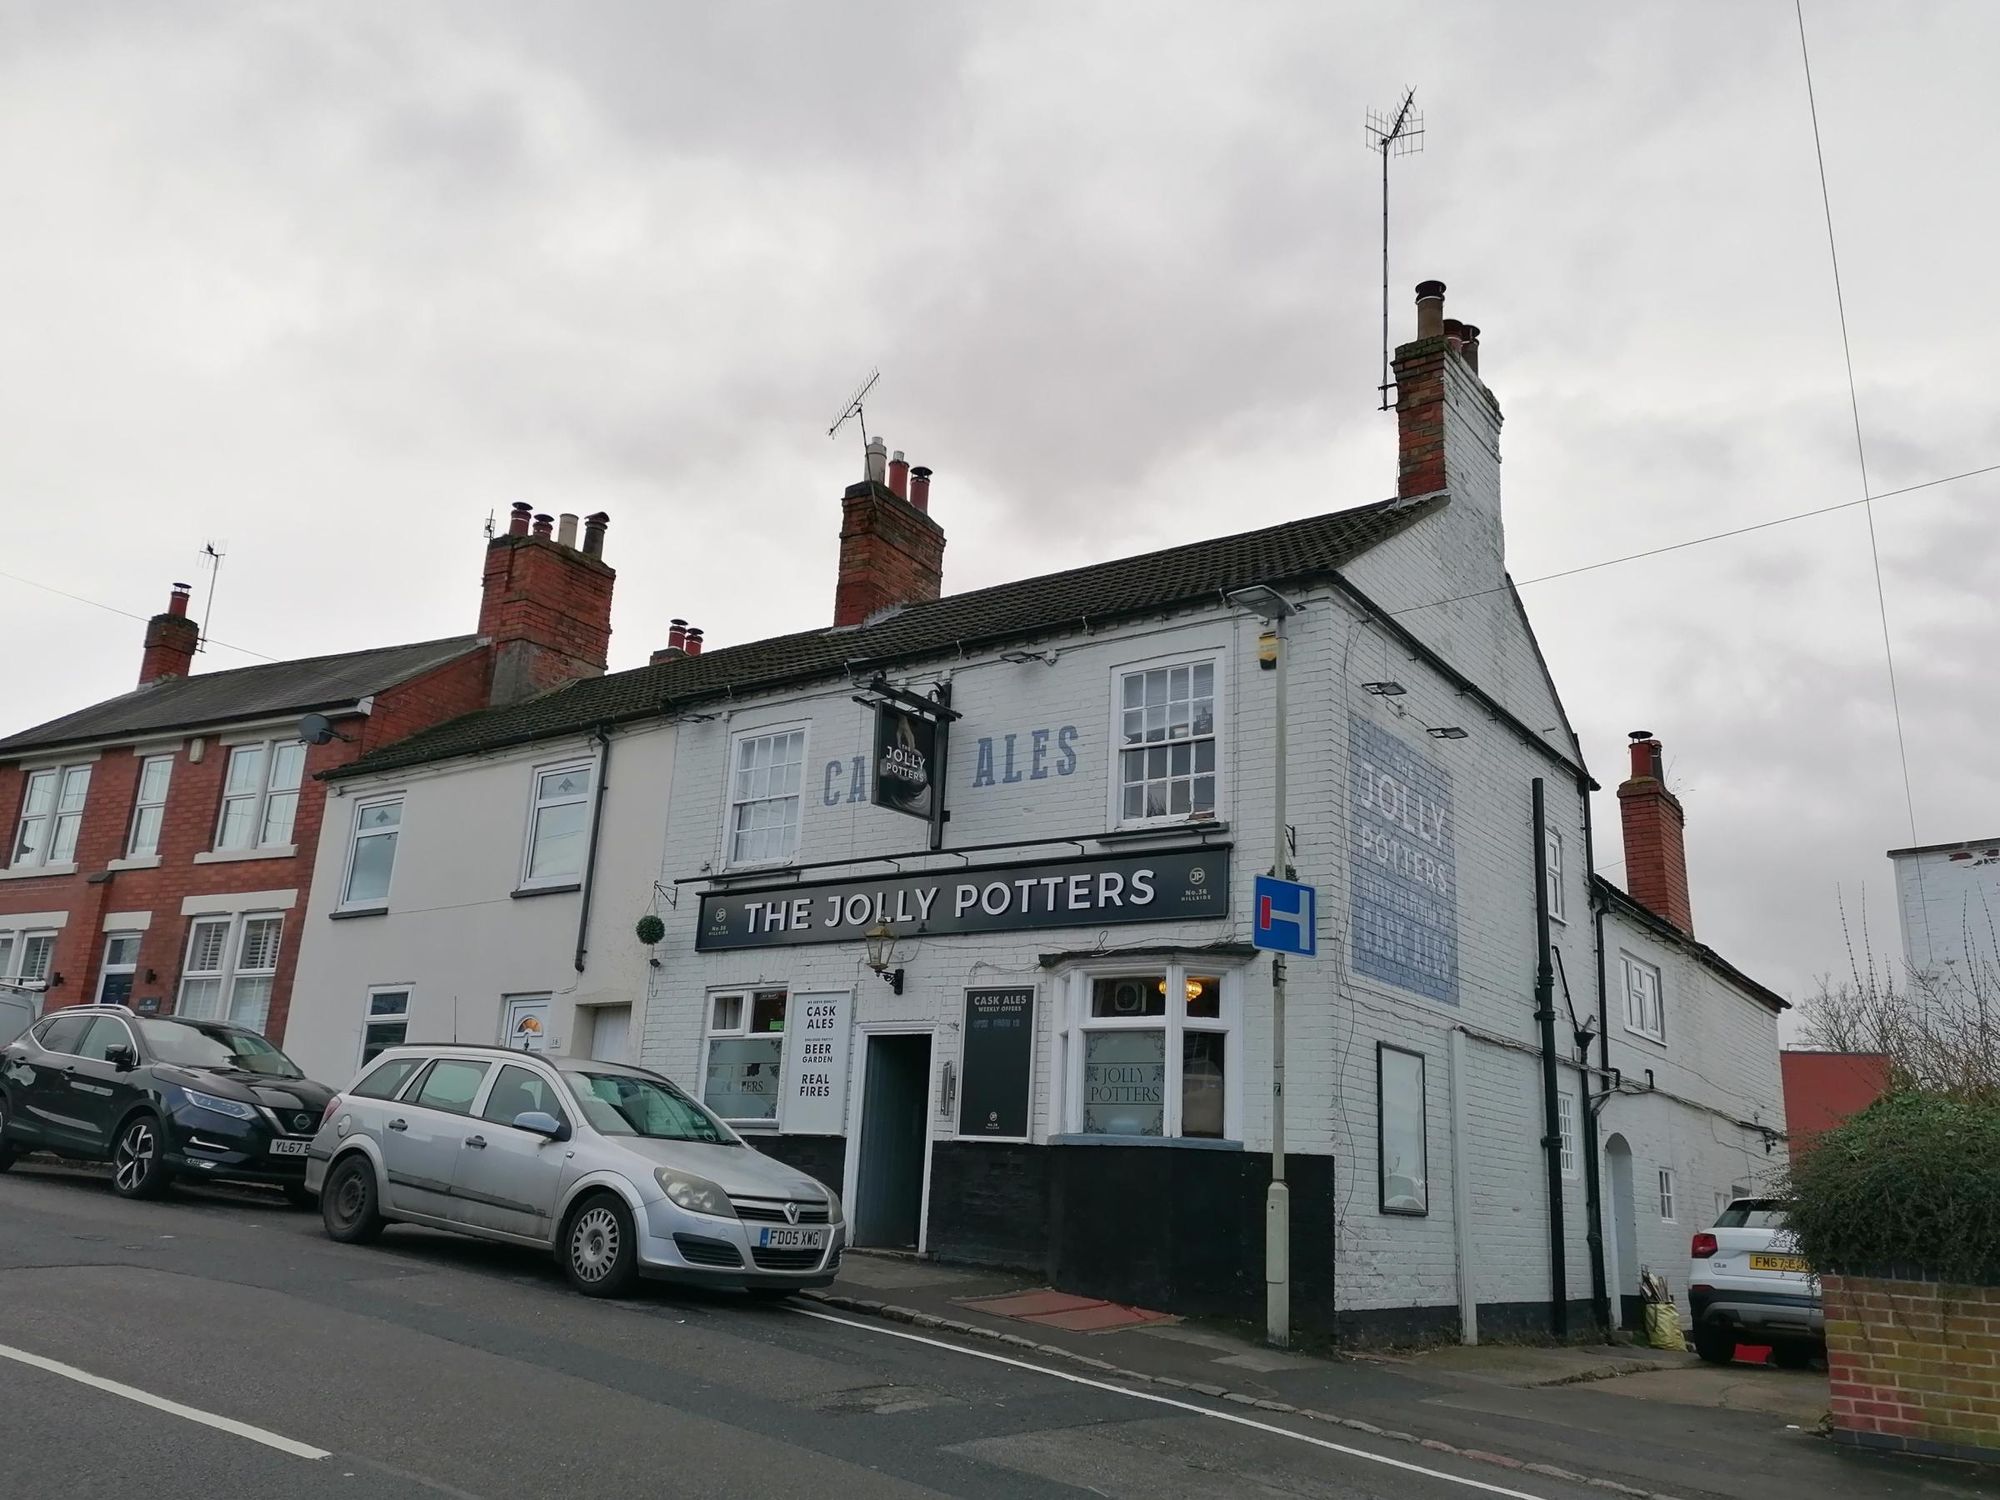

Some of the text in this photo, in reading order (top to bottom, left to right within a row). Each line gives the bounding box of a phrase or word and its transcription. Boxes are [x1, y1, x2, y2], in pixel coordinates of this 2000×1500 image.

[824, 725, 1079, 806] CA ALES
[886, 745, 926, 770] JOLLY
[886, 762, 924, 782] POTTERS
[1393, 757, 1414, 780] THE
[1359, 761, 1446, 847] JOLLY
[1361, 824, 1448, 893] POTTERS
[744, 868, 1157, 933] THE JOLLY POTTERS
[974, 995, 1027, 1006] CASK ALES
[806, 1005, 837, 1017] CASK
[807, 1018, 834, 1030] ALES
[805, 1043, 832, 1055] BEER
[802, 1055, 833, 1064] GARDEN
[801, 1073, 830, 1085] REAL
[1103, 1067, 1143, 1085] JOLLY
[799, 1086, 830, 1098] FIRES
[1091, 1086, 1160, 1102] POTTERS
[276, 1141, 303, 1153] YL67
[769, 1230, 819, 1246] FD05 XWG
[1755, 1256, 1785, 1268] FM67
